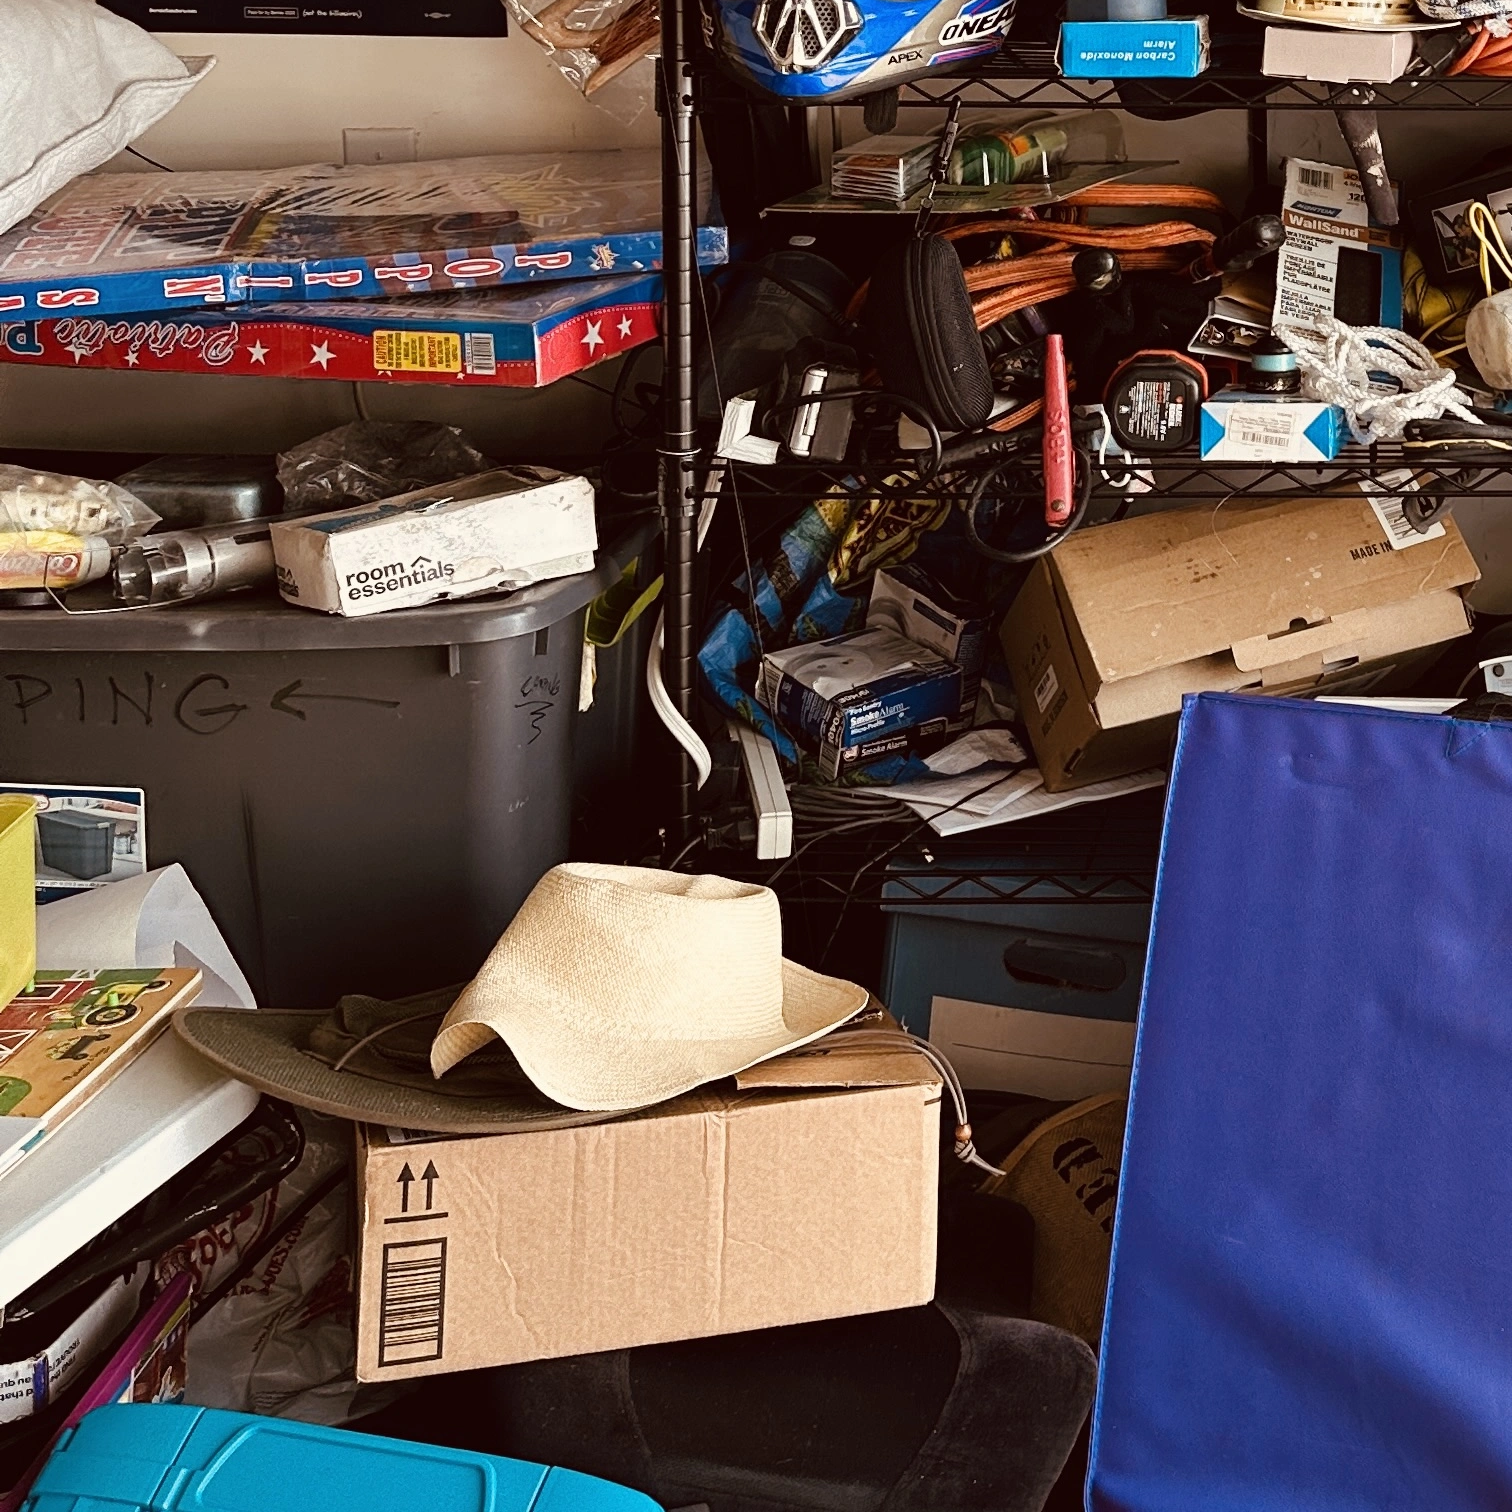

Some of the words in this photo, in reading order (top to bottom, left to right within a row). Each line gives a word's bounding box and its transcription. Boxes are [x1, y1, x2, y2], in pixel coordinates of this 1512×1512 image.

[942, 2, 1017, 43] ONEA
[1079, 51, 1134, 61] Monoxide
[1136, 51, 1176, 61] Carbon
[1143, 40, 1176, 50] Alarm
[887, 49, 925, 67] APEX
[164, 251, 573, 302] POPPIN'
[0, 319, 41, 355] P
[54, 319, 239, 365] Patriotic
[1349, 543, 1380, 561] MADE
[1380, 540, 1393, 553] IN
[344, 562, 405, 586] room
[348, 560, 456, 601] essentials
[3, 672, 249, 735] PING
[861, 744, 887, 758] Smoke
[887, 739, 908, 753] Alarm
